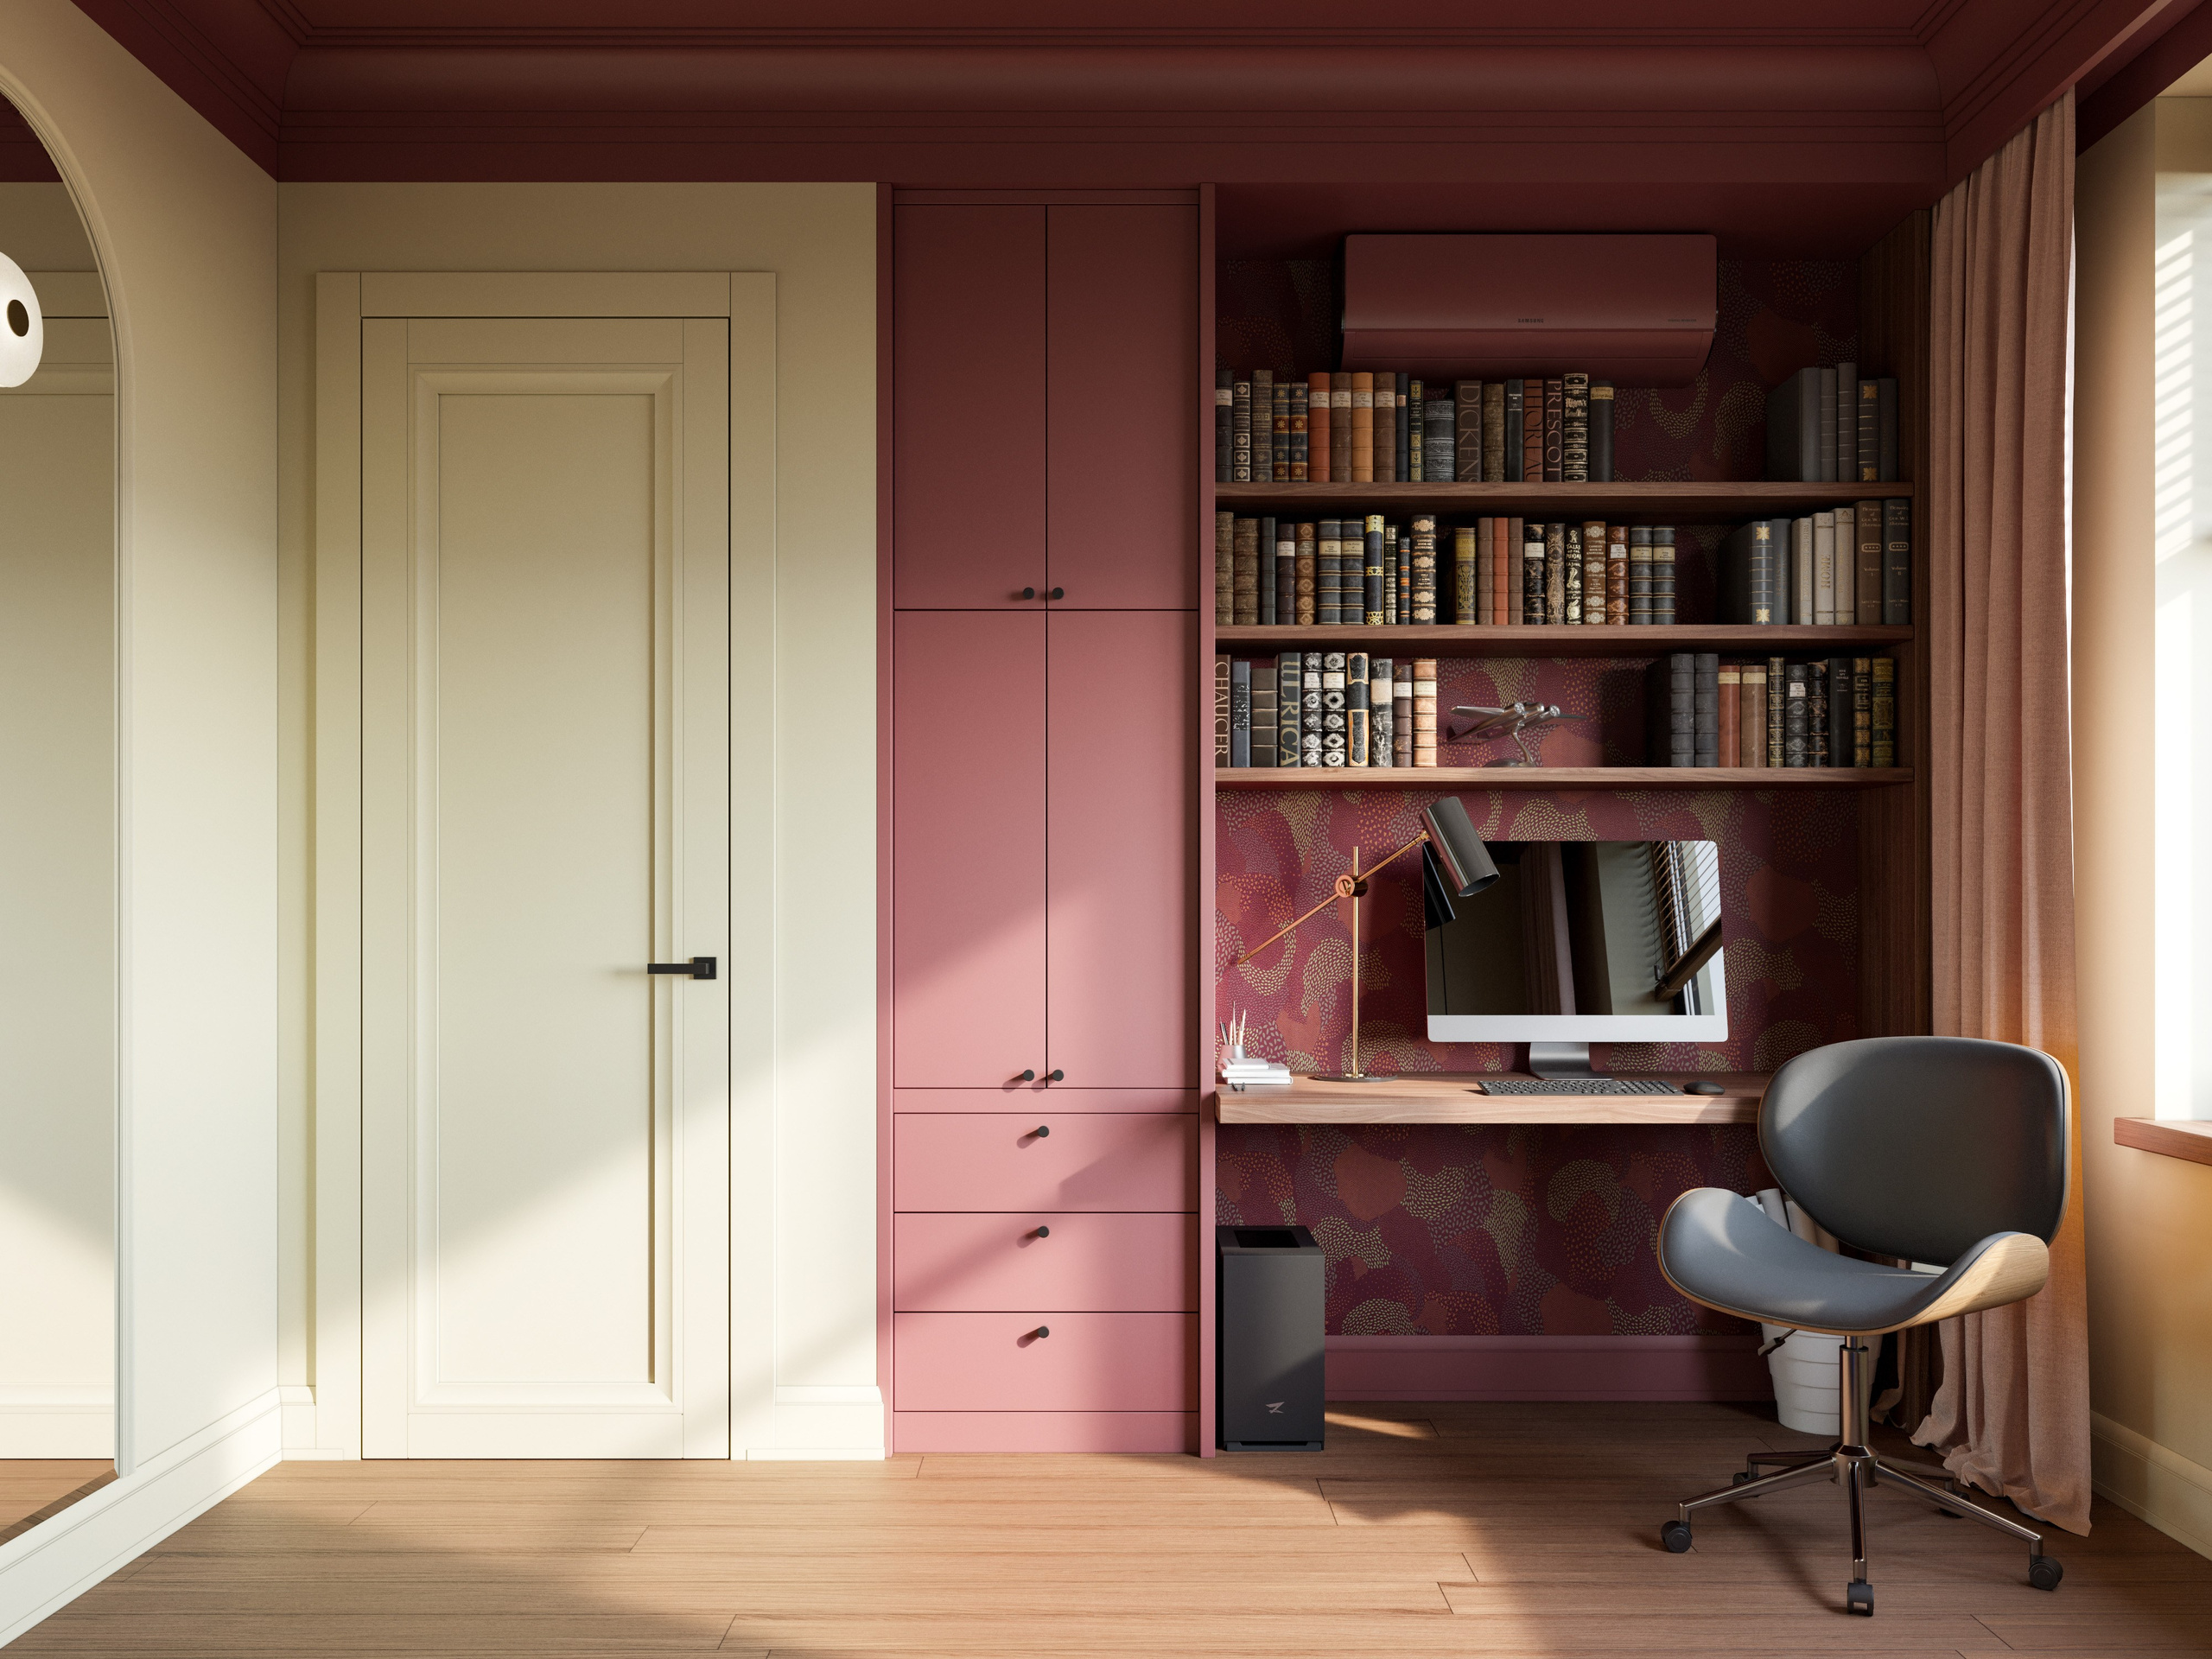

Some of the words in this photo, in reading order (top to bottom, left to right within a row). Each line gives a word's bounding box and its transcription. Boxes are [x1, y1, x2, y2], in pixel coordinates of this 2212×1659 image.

[1547, 381, 1561, 481] PRESCOT
[1821, 555, 1831, 588] HOME
[1215, 662, 1229, 756] CHAUCER
[1280, 661, 1300, 766] ULRICA
